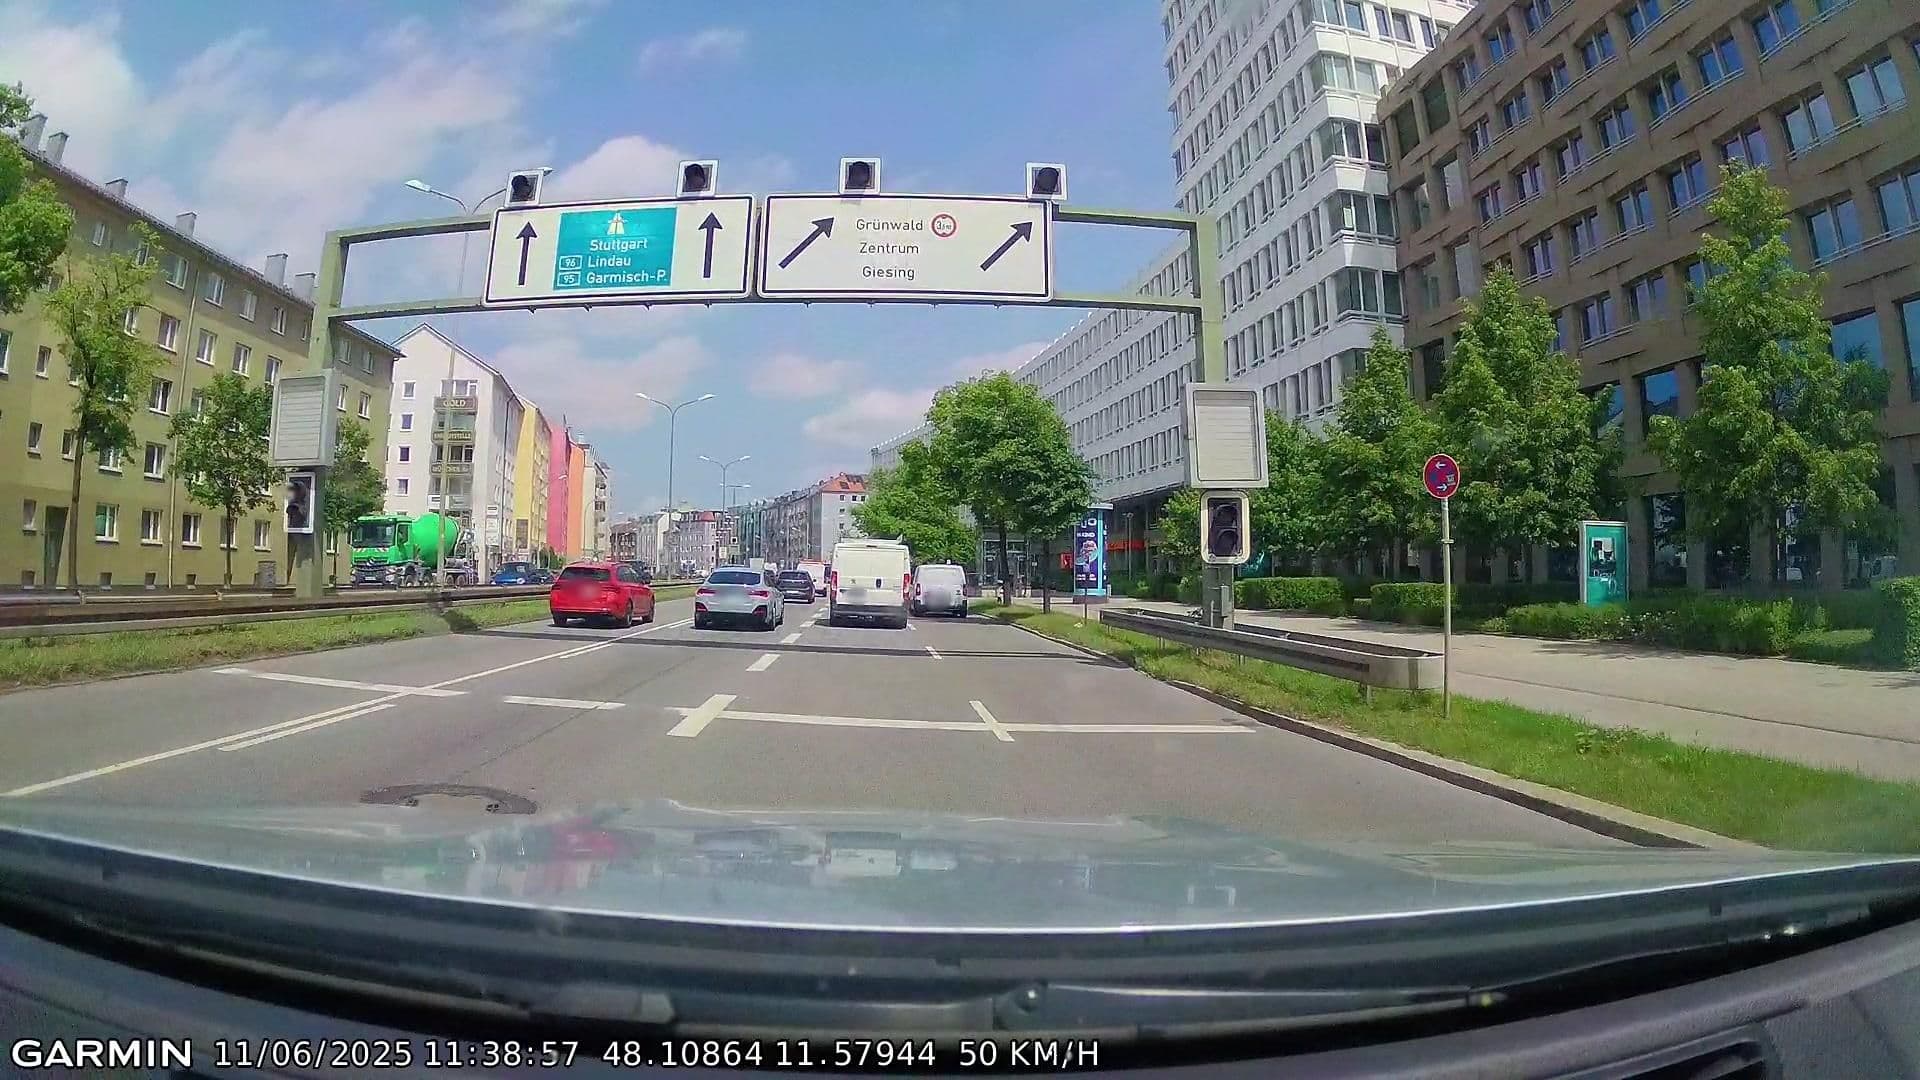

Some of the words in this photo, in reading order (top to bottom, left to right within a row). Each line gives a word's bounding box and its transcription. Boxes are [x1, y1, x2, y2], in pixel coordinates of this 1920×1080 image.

[856, 218, 923, 231] Grünwald
[589, 237, 648, 253] Stuttgart
[859, 242, 919, 254] Zentrum
[564, 257, 577, 268] 96
[588, 254, 632, 268] Lindau
[563, 274, 575, 284] 95
[586, 269, 667, 284] Garmisch-P.
[862, 265, 915, 281] Giesing
